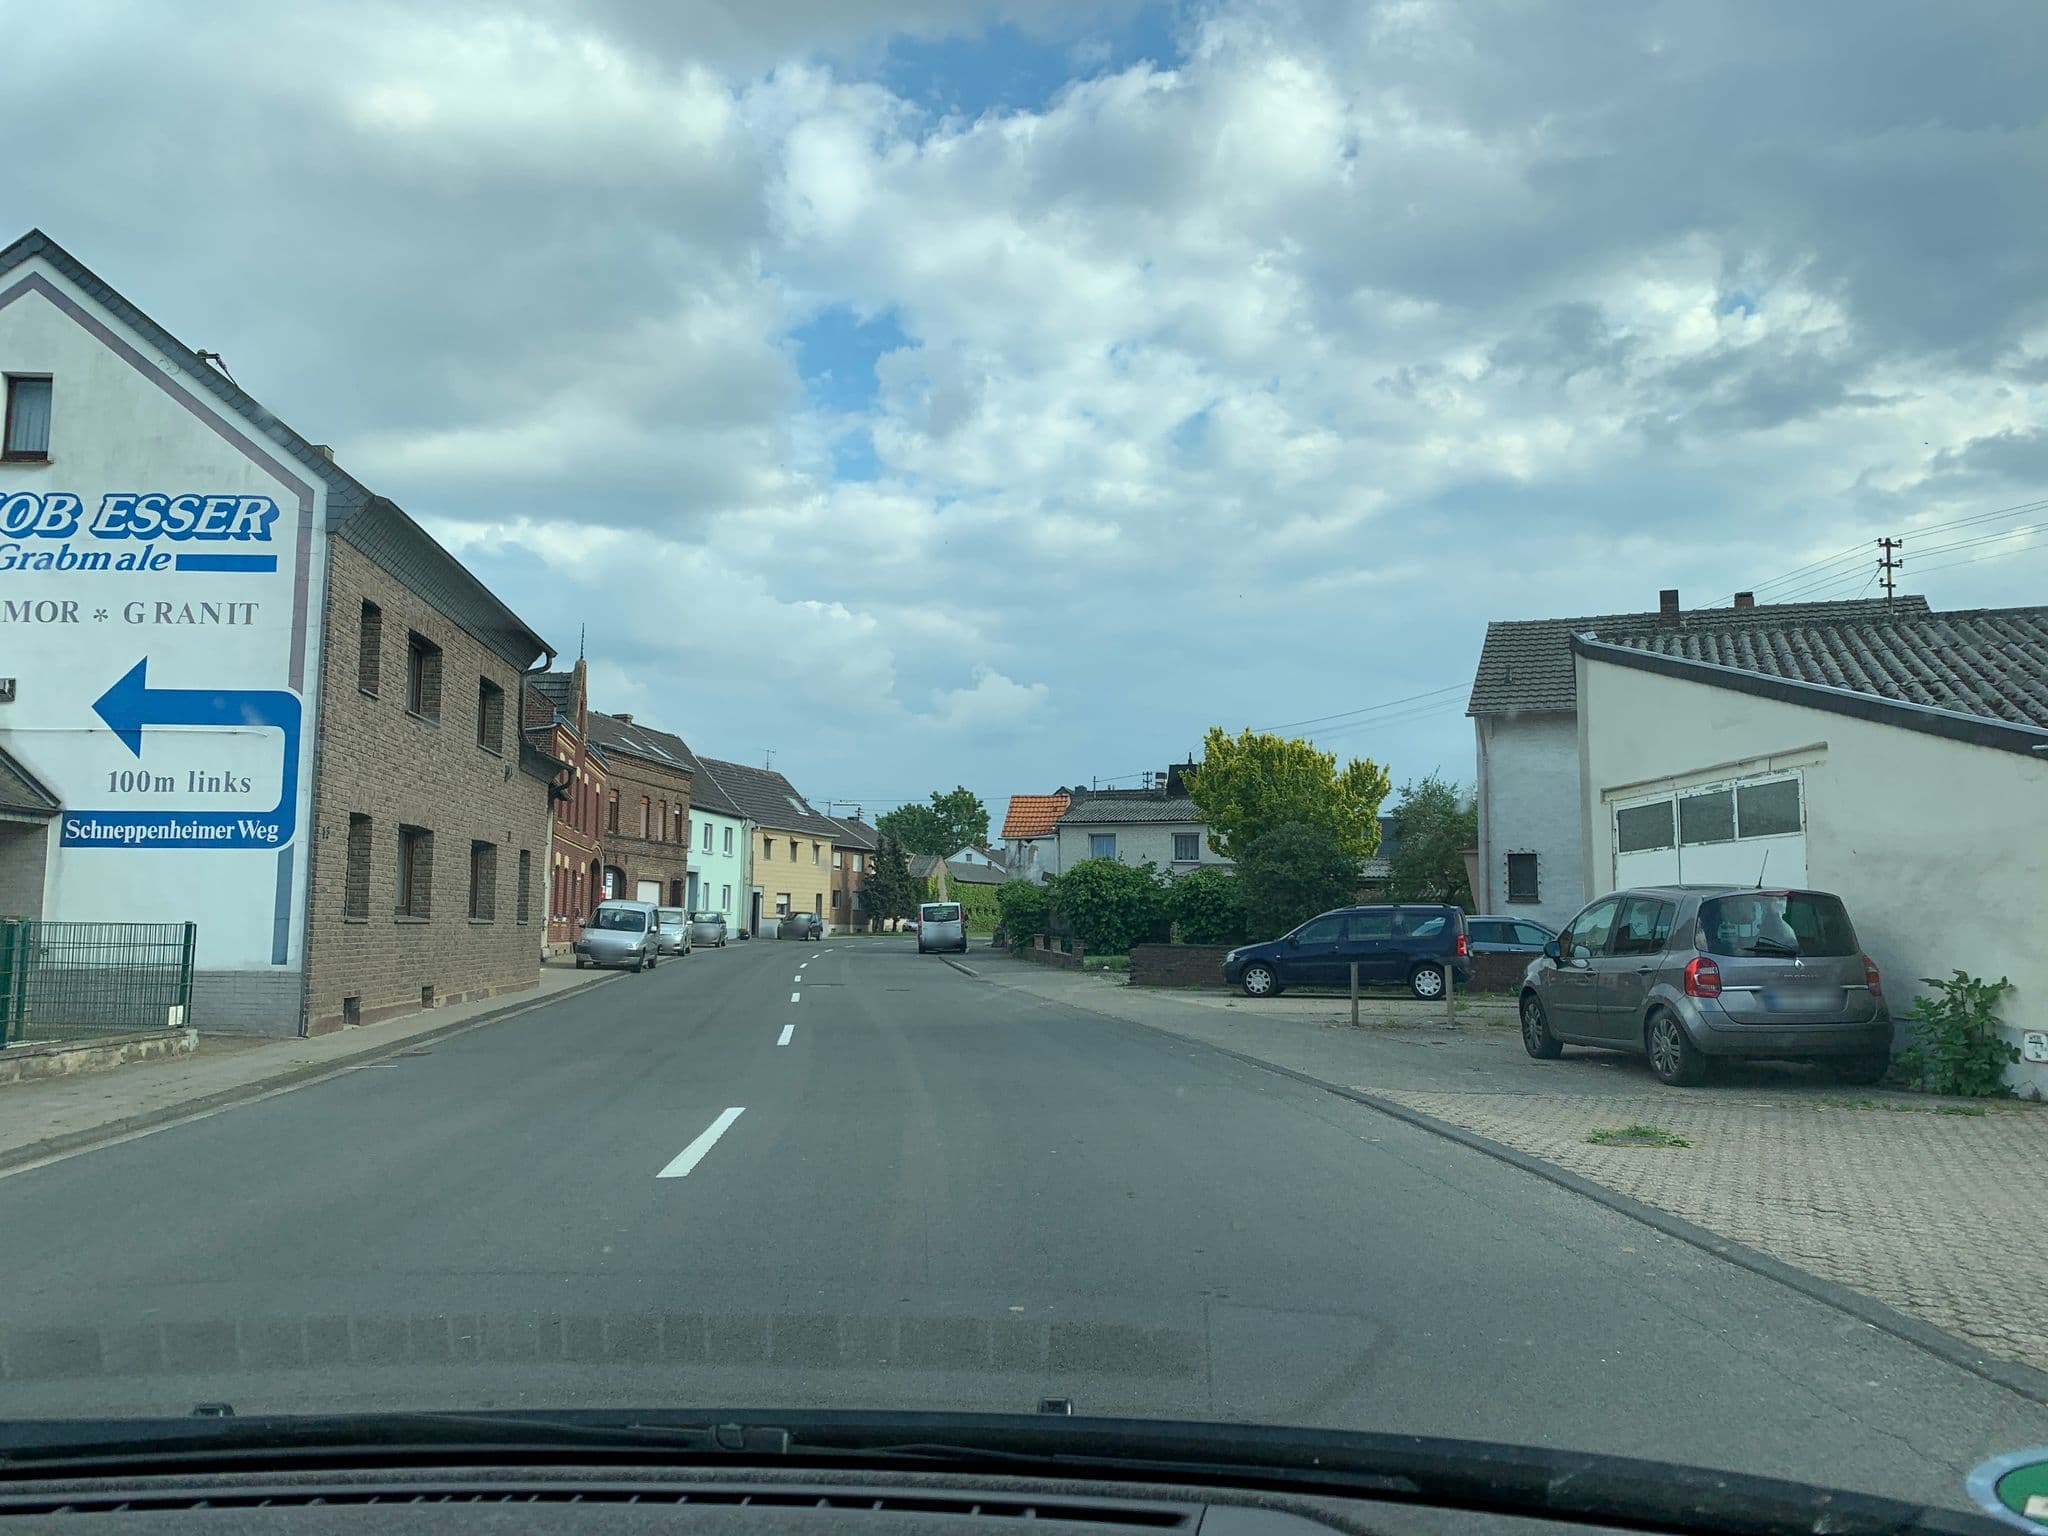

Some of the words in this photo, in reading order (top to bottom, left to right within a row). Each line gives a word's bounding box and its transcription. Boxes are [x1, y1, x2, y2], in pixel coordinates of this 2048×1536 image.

[0, 492, 83, 539] OB
[89, 493, 280, 541] ESSER
[0, 543, 172, 571] Grabmale
[123, 601, 259, 625] GRANIT
[107, 770, 175, 793] 100m
[187, 770, 251, 793] links
[65, 819, 235, 843] Schneppenheimer
[237, 820, 279, 842] Weg
